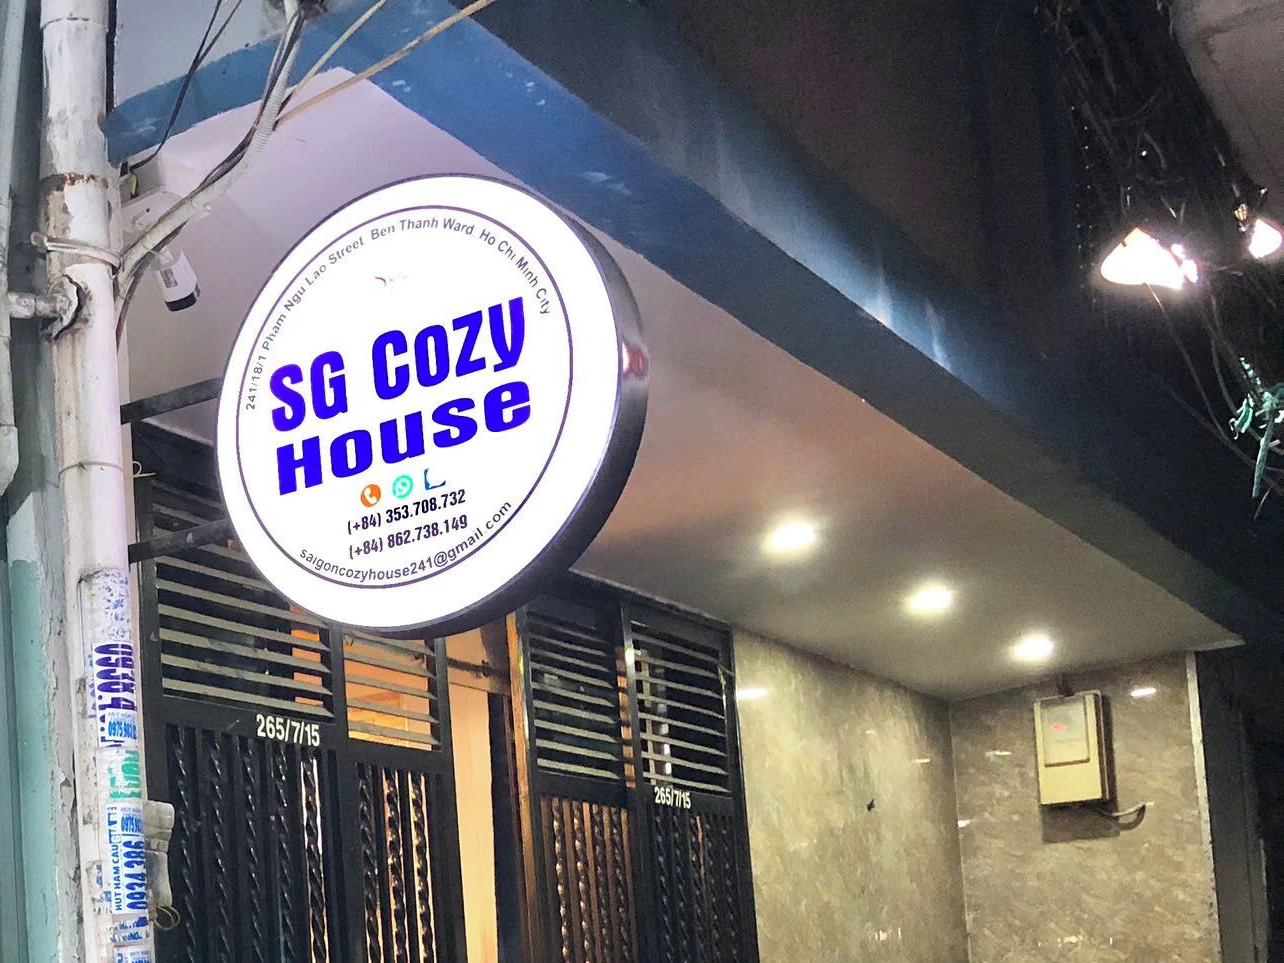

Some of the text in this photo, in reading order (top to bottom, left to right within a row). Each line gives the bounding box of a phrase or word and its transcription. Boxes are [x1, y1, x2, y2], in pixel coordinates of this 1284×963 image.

[246, 217, 551, 411] 241/18/1 Pham Ngu Lao Street Ben Thanh Ward Ho Chi Minh City
[269, 350, 348, 432] SG
[347, 488, 466, 535] (+84) 353.708.732
[349, 514, 468, 560] (+84) 862.738.149
[256, 713, 320, 747] 265/7/15
[654, 786, 692, 809] 265/7/15
